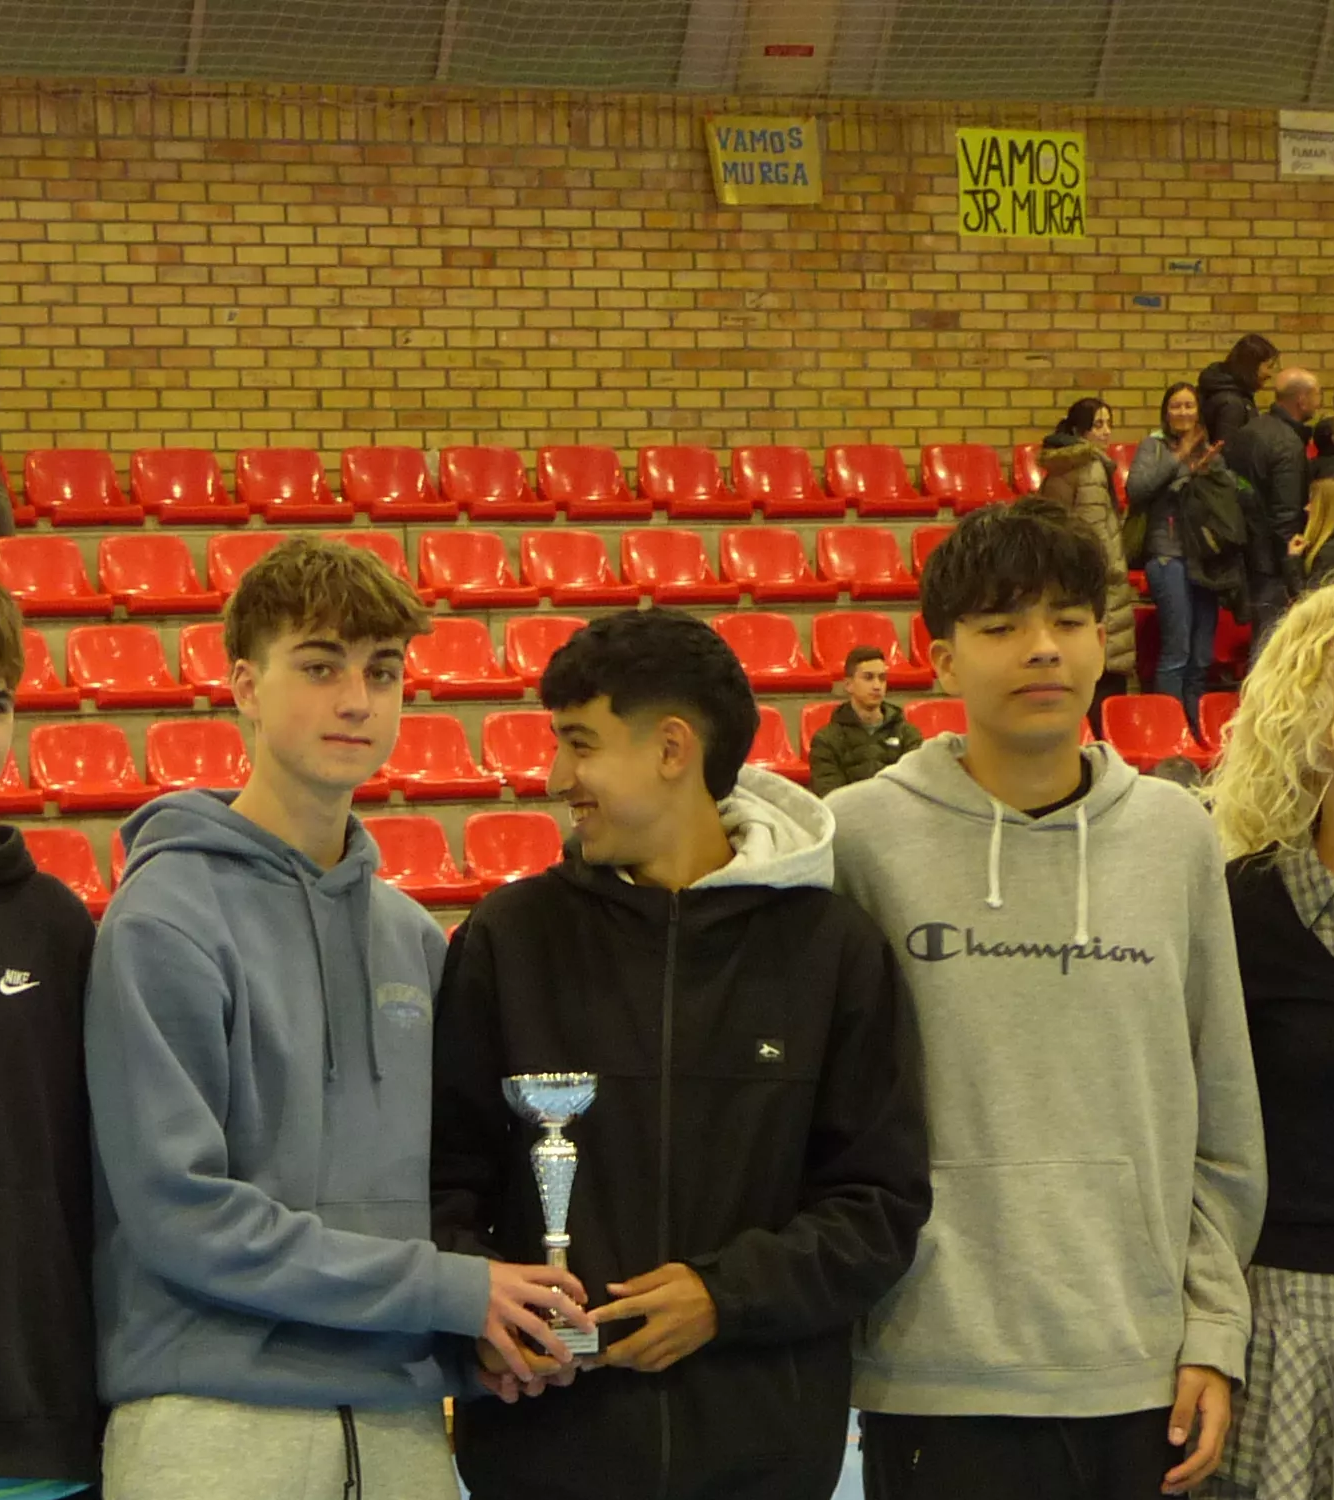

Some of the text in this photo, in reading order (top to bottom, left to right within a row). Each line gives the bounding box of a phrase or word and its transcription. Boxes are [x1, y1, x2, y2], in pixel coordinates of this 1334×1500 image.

[717, 126, 804, 154] VAMOS
[960, 136, 1080, 189] VAMOS
[722, 161, 810, 186] MURGA
[963, 188, 1085, 235] JR. MURGA
[906, 922, 1155, 975] Champion
